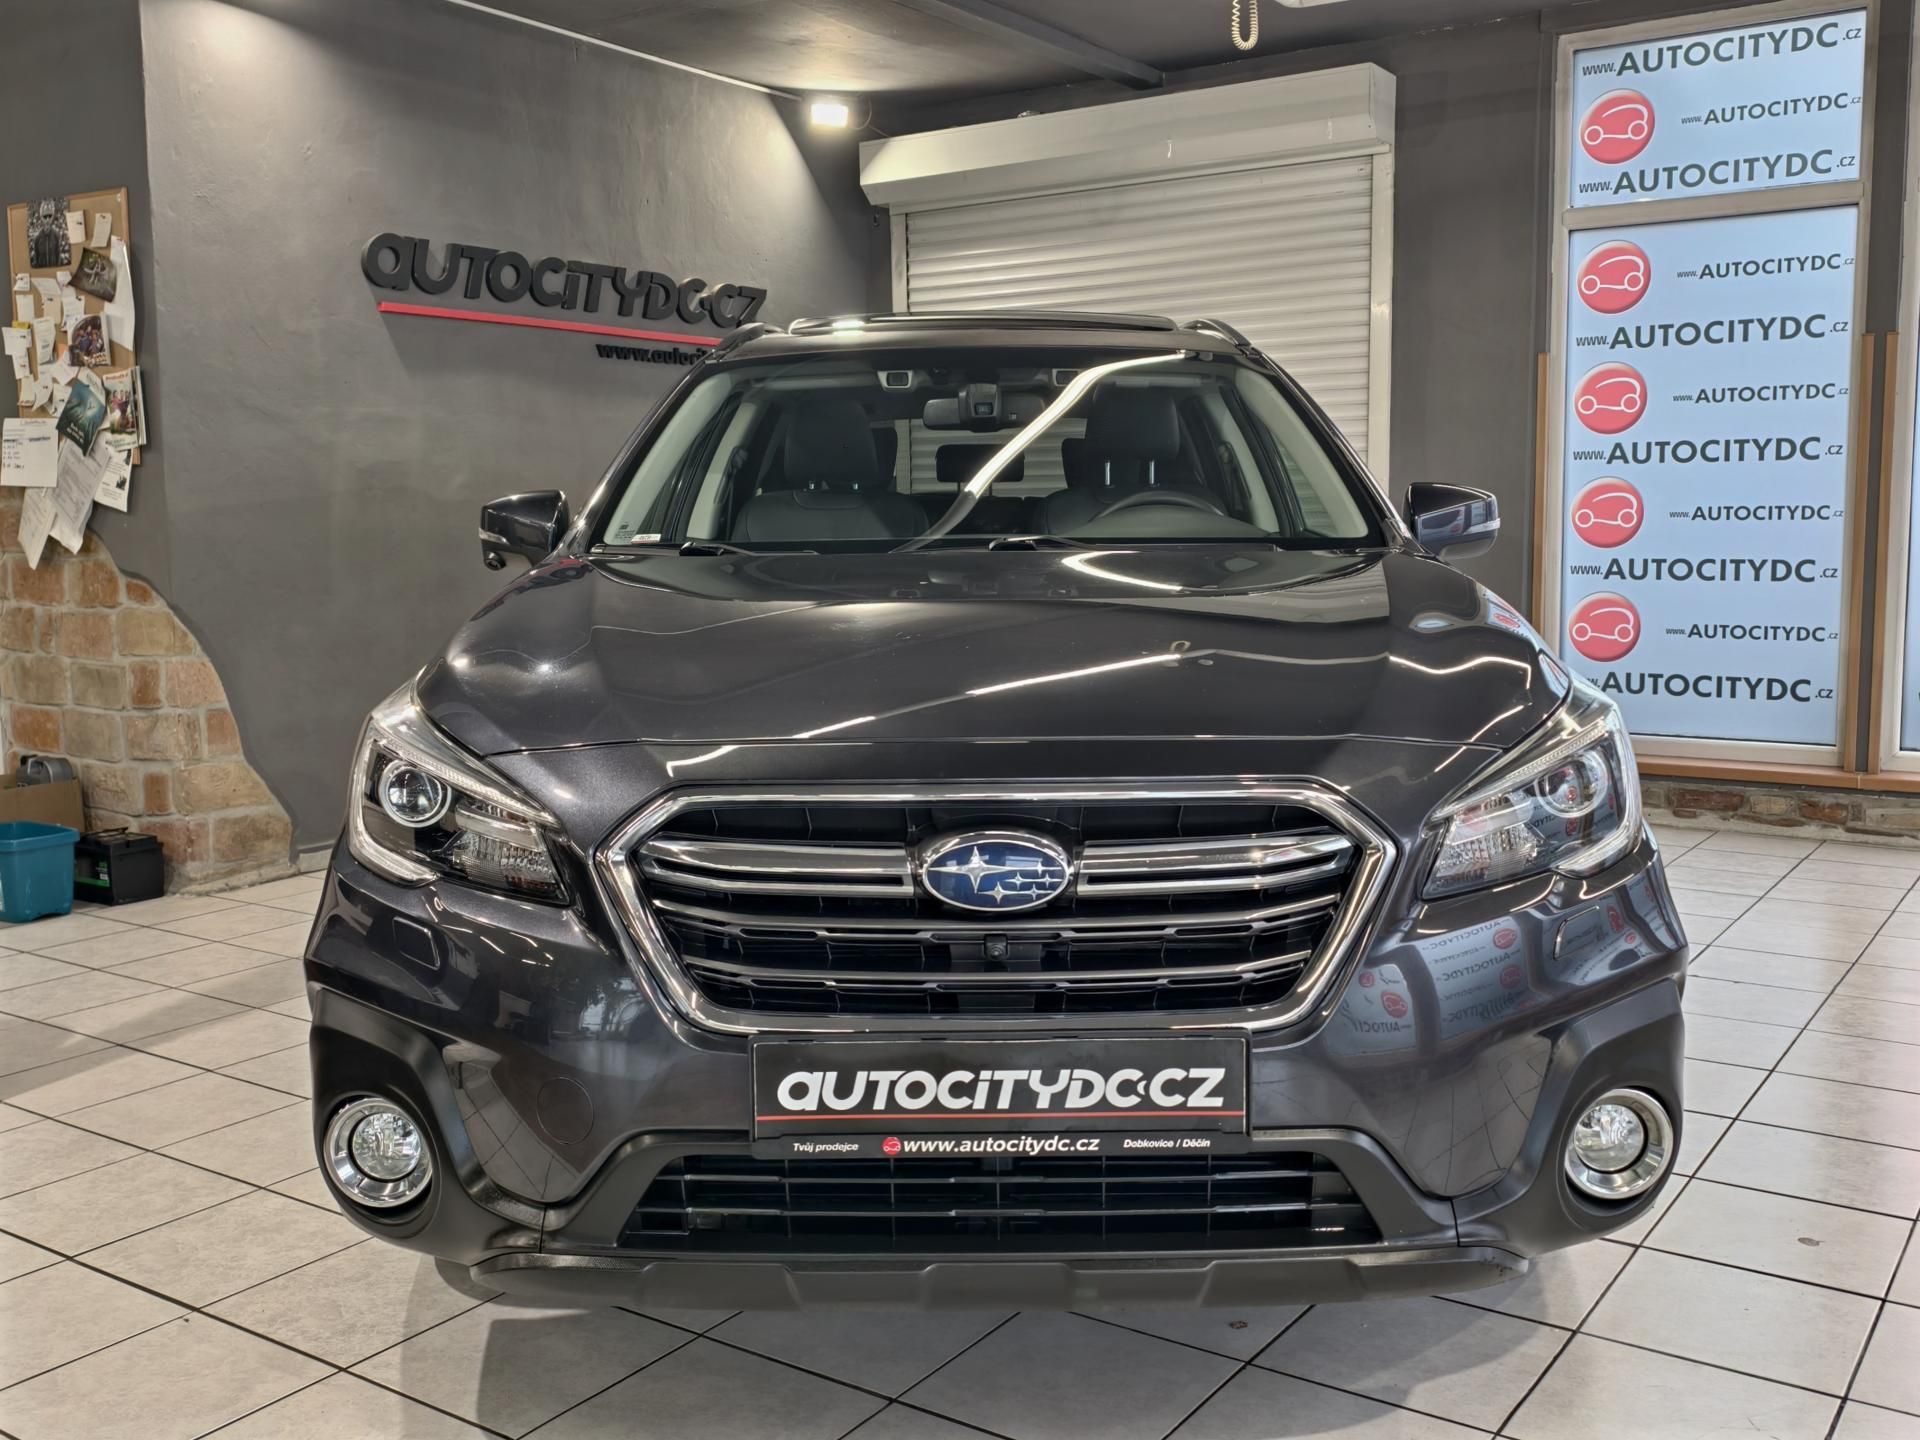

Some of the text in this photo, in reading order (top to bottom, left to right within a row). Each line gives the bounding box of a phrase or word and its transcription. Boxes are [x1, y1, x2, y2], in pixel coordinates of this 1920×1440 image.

[1582, 22, 1862, 76] www.AUTOCITYDC.cz
[1681, 92, 1863, 125] www.AUTOCITYDC.cz
[1579, 149, 1855, 195] www.AUTOCITYDC.cz
[1677, 254, 1855, 279] www.AUTOCITYDC.cz
[1576, 314, 1848, 349] www.AUTOCITYDC.cz
[1672, 383, 1849, 404] www.AUTOCITYDC.cz
[1573, 437, 1843, 465] www.AUTOCITYDC.cz
[1669, 504, 1844, 521] www.AUTOCITYDC.cz
[1570, 558, 1838, 583] www.AUTOCITYDC.cz
[1666, 624, 1839, 642] www.AUTOCITYDC.cz
[793, 1142, 813, 1153] Tvůj
[815, 1143, 860, 1153] prodejce
[903, 1135, 1101, 1155] www.autocitydc.cz
[1123, 1138, 1174, 1148] Dobkovice
[1182, 1138, 1211, 1148] Děčín
